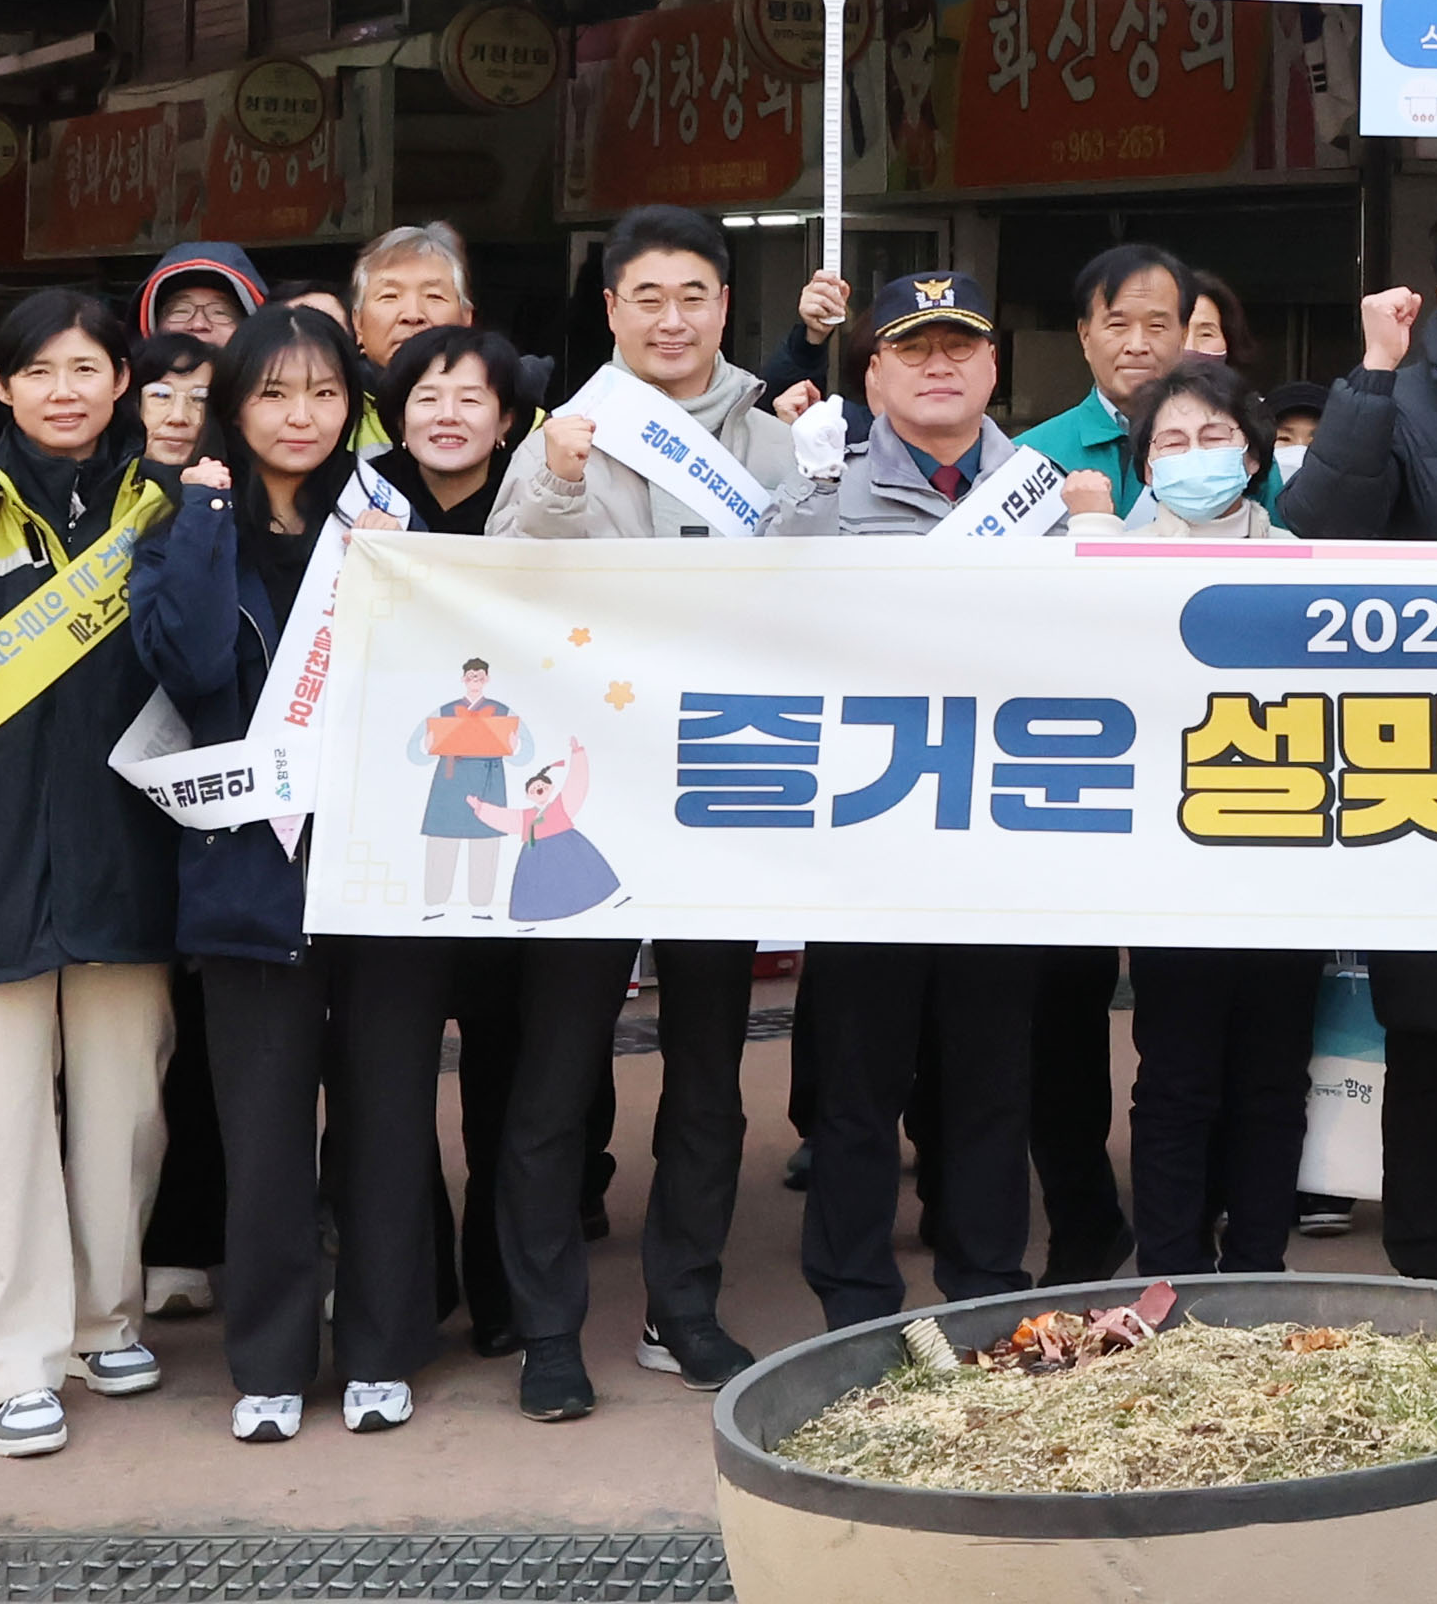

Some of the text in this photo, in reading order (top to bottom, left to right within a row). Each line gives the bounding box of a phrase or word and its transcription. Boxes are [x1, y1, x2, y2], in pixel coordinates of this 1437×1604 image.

[641, 418, 690, 464] 생활
[1000, 460, 1059, 523] 대국민
[66, 570, 132, 646] 시설
[171, 765, 255, 810] 캠페인
[675, 692, 1138, 834] 즐거운
[1344, 1077, 1374, 1105] 함양
